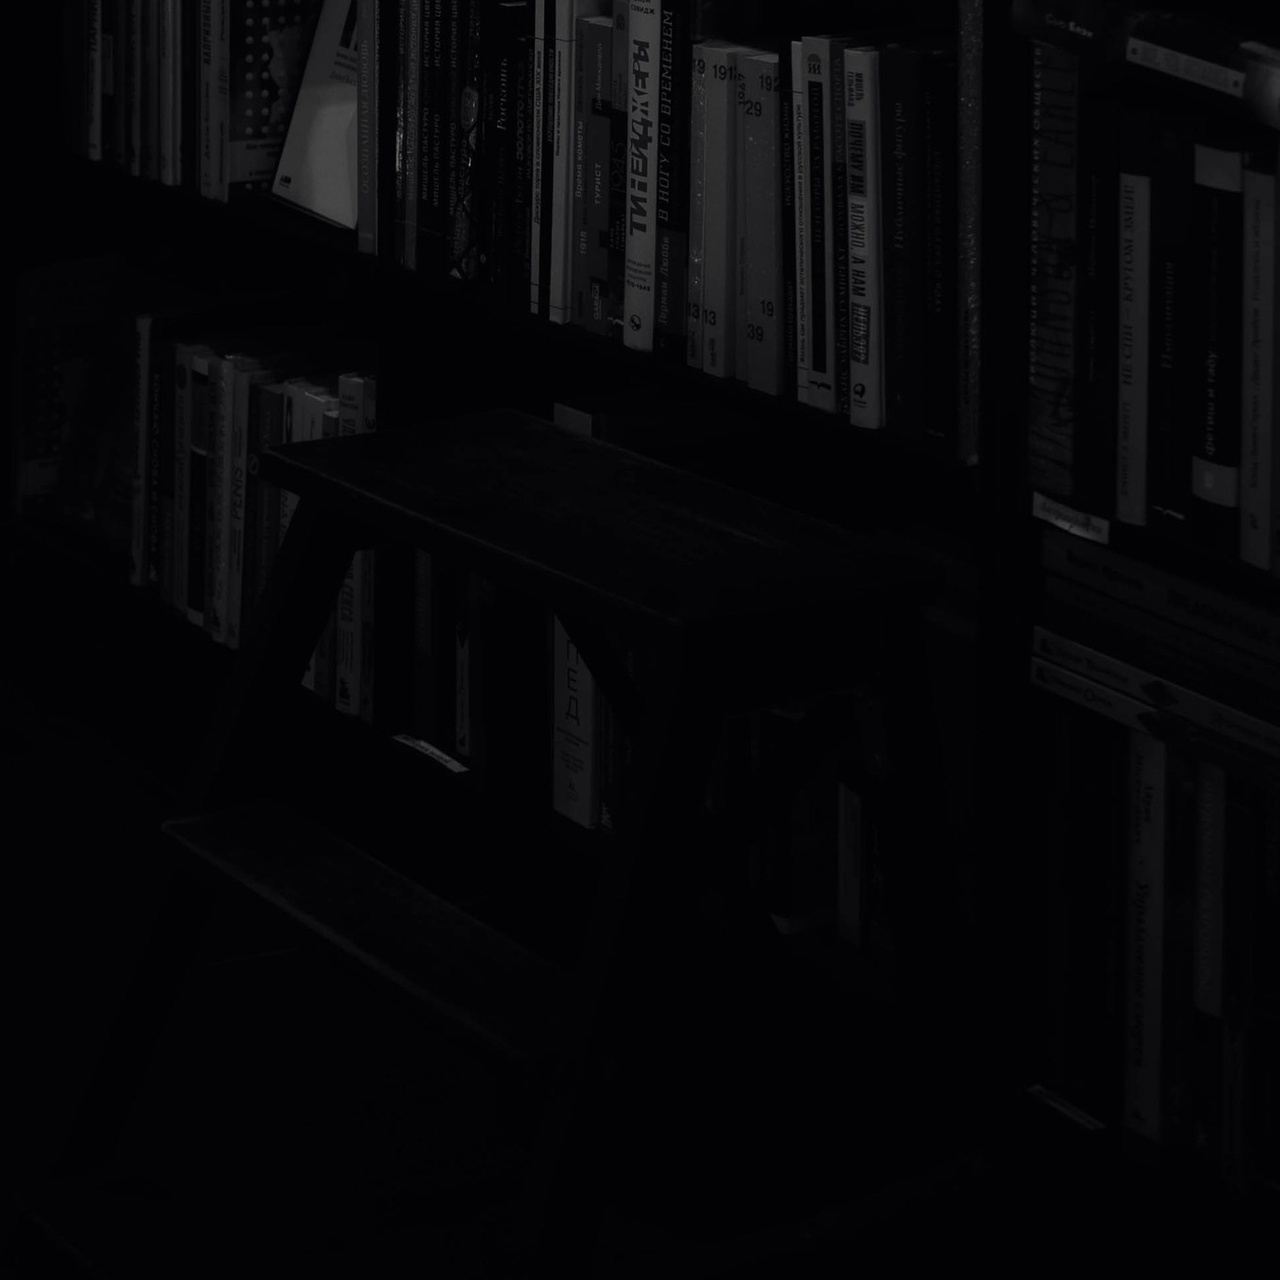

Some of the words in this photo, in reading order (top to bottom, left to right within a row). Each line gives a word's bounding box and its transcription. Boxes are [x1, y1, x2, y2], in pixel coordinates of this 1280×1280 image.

[423, 21, 431, 68] ИСТОРИЯ
[434, 20, 442, 68] ИСТОРИЯ
[450, 22, 458, 68] ИСТОРИЯ
[661, 10, 674, 117] ВРЕМЕНЕМ
[496, 57, 509, 131] Роскошь
[746, 99, 763, 118] 29
[433, 113, 441, 159] ПАСТУРО
[575, 121, 584, 161] кометы
[630, 39, 653, 236] ТИНЕЙДЖЕРЫ
[660, 125, 670, 147] СО
[849, 122, 865, 172] ПОЧЕМУ
[449, 170, 457, 216] МИШЕЛЬ
[574, 164, 584, 198] Время
[593, 162, 602, 205] ТУРИСТ
[659, 156, 670, 200] НОГУ
[851, 175, 865, 195] ИМ
[659, 210, 668, 222] В
[850, 203, 866, 249] МОЖНО,
[1123, 183, 1135, 234] ЗМЕИ!
[579, 230, 588, 255] 1918
[852, 256, 866, 267] А
[852, 270, 866, 297] НАМ
[1123, 238, 1135, 303] КРУГОМ
[703, 308, 717, 326] 13
[761, 299, 775, 317] 19
[747, 323, 764, 341] 39
[1122, 324, 1134, 362] СПИ
[1122, 365, 1133, 386] НЕ
[230, 466, 244, 520] PENIS
